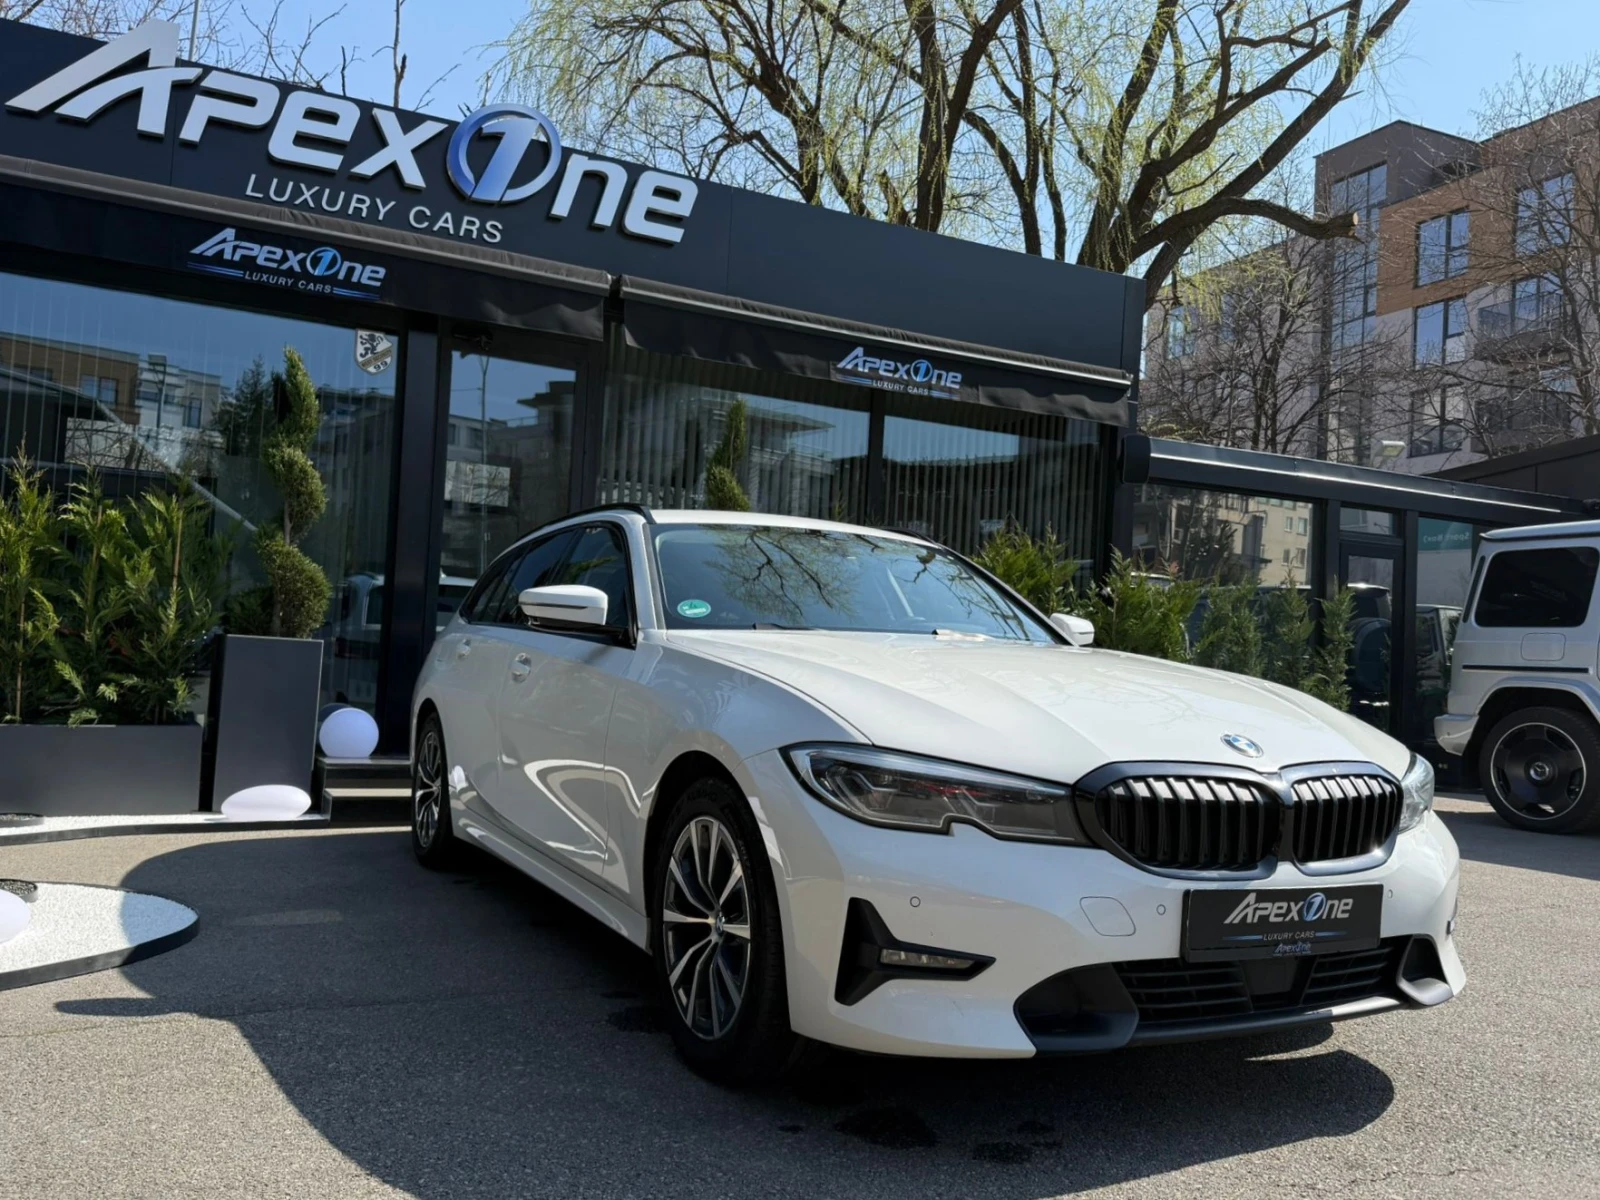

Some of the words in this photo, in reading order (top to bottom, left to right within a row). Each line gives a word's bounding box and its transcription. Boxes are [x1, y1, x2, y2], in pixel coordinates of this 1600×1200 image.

[245, 174, 395, 221] LUXURY
[409, 206, 502, 243] CARS
[245, 271, 294, 287] LUXURY
[298, 280, 332, 294] CARS
[873, 380, 904, 391] LUXURY
[907, 386, 929, 395] CARS
[1263, 932, 1293, 941] LUXURY
[1294, 930, 1316, 939] CARS
